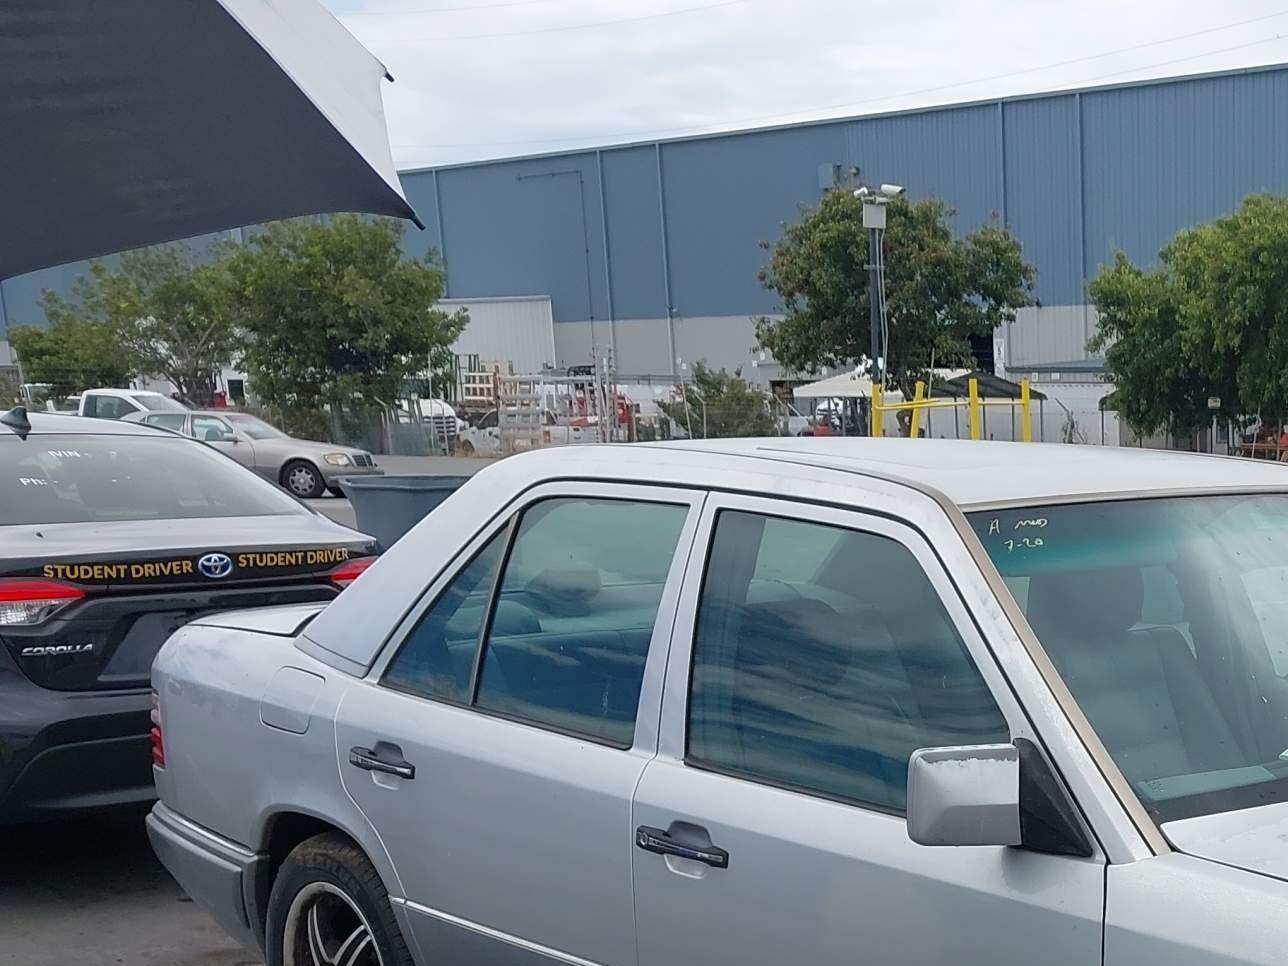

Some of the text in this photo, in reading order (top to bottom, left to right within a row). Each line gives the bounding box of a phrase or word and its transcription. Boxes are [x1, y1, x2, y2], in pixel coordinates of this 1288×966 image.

[988, 518, 1000, 536] A
[1003, 537, 1044, 552] 7-20
[238, 548, 349, 568] STUDENT DRIVER
[43, 560, 193, 579] STUDENT DRIVER
[21, 643, 93, 656] COROLLA
